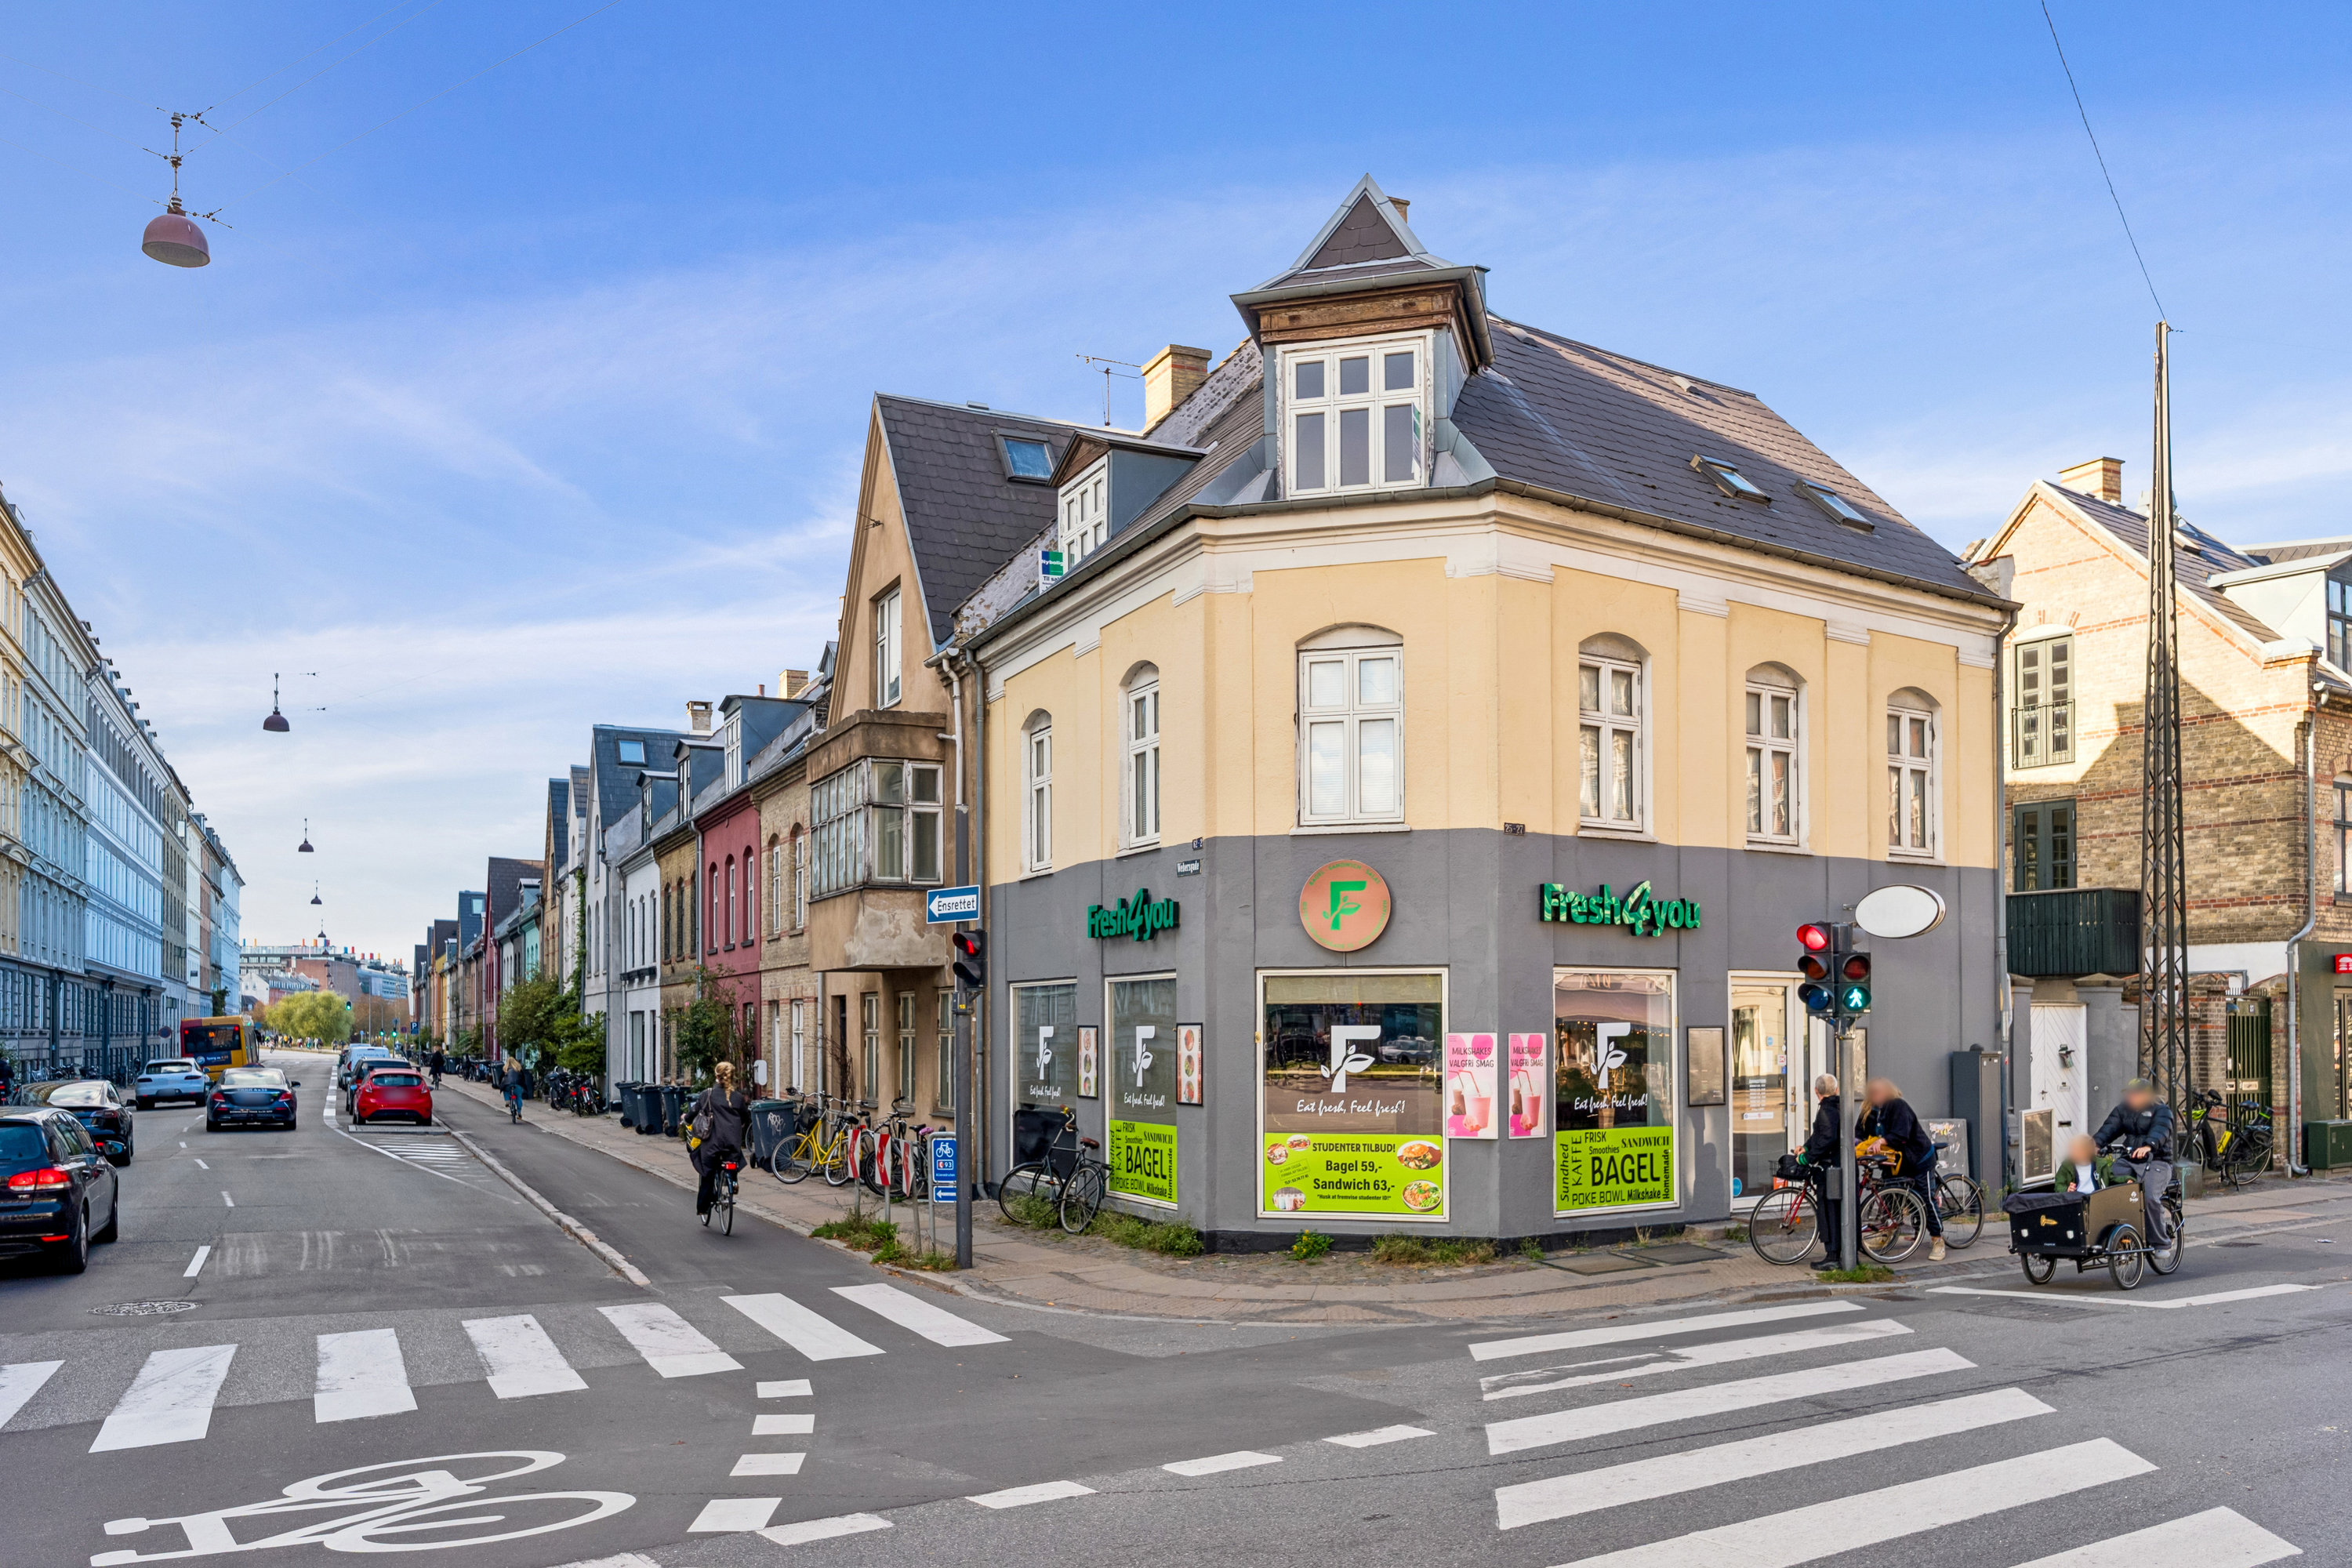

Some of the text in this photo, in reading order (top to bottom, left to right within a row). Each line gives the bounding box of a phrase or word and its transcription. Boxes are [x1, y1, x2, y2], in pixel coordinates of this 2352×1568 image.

[1177, 860, 1200, 873] Webersgade
[938, 898, 975, 912] Ensrettet
[1540, 880, 1700, 937] Fresh4you
[1087, 887, 1178, 942] Fresh4you
[1476, 1059, 1494, 1068] SMAG
[1530, 1058, 1544, 1067] SMAG
[1297, 1099, 1406, 1117] Eat fresh, Feel fresh!
[1574, 1097, 1588, 1110] Eat
[1611, 1094, 1627, 1109] Feel
[1628, 1093, 1648, 1111] fresh!
[1123, 1122, 1136, 1133] FRISK
[1125, 1135, 1143, 1145] Smoothies
[1144, 1131, 1173, 1145] SANDWICH
[1584, 1131, 1606, 1143] FRISK
[1621, 1136, 1669, 1148] SANDWICH
[1312, 1143, 1396, 1152] STUDENTER TILBUD!
[1589, 1145, 1620, 1155] Smoothies
[1126, 1145, 1167, 1180] BAGEL
[1326, 1160, 1383, 1174] Bagel 59,-
[1572, 1135, 1582, 1186] KAFFE
[1559, 1143, 1569, 1202] Sundhed
[1592, 1152, 1661, 1187] BAGEL
[1116, 1177, 1145, 1192] POKE BOWL
[1147, 1182, 1167, 1197] Milkshake
[1313, 1178, 1395, 1192] Sandwich 63,-
[1572, 1190, 1625, 1206] POKE BOWL
[1627, 1188, 1661, 1202] Milkshake
